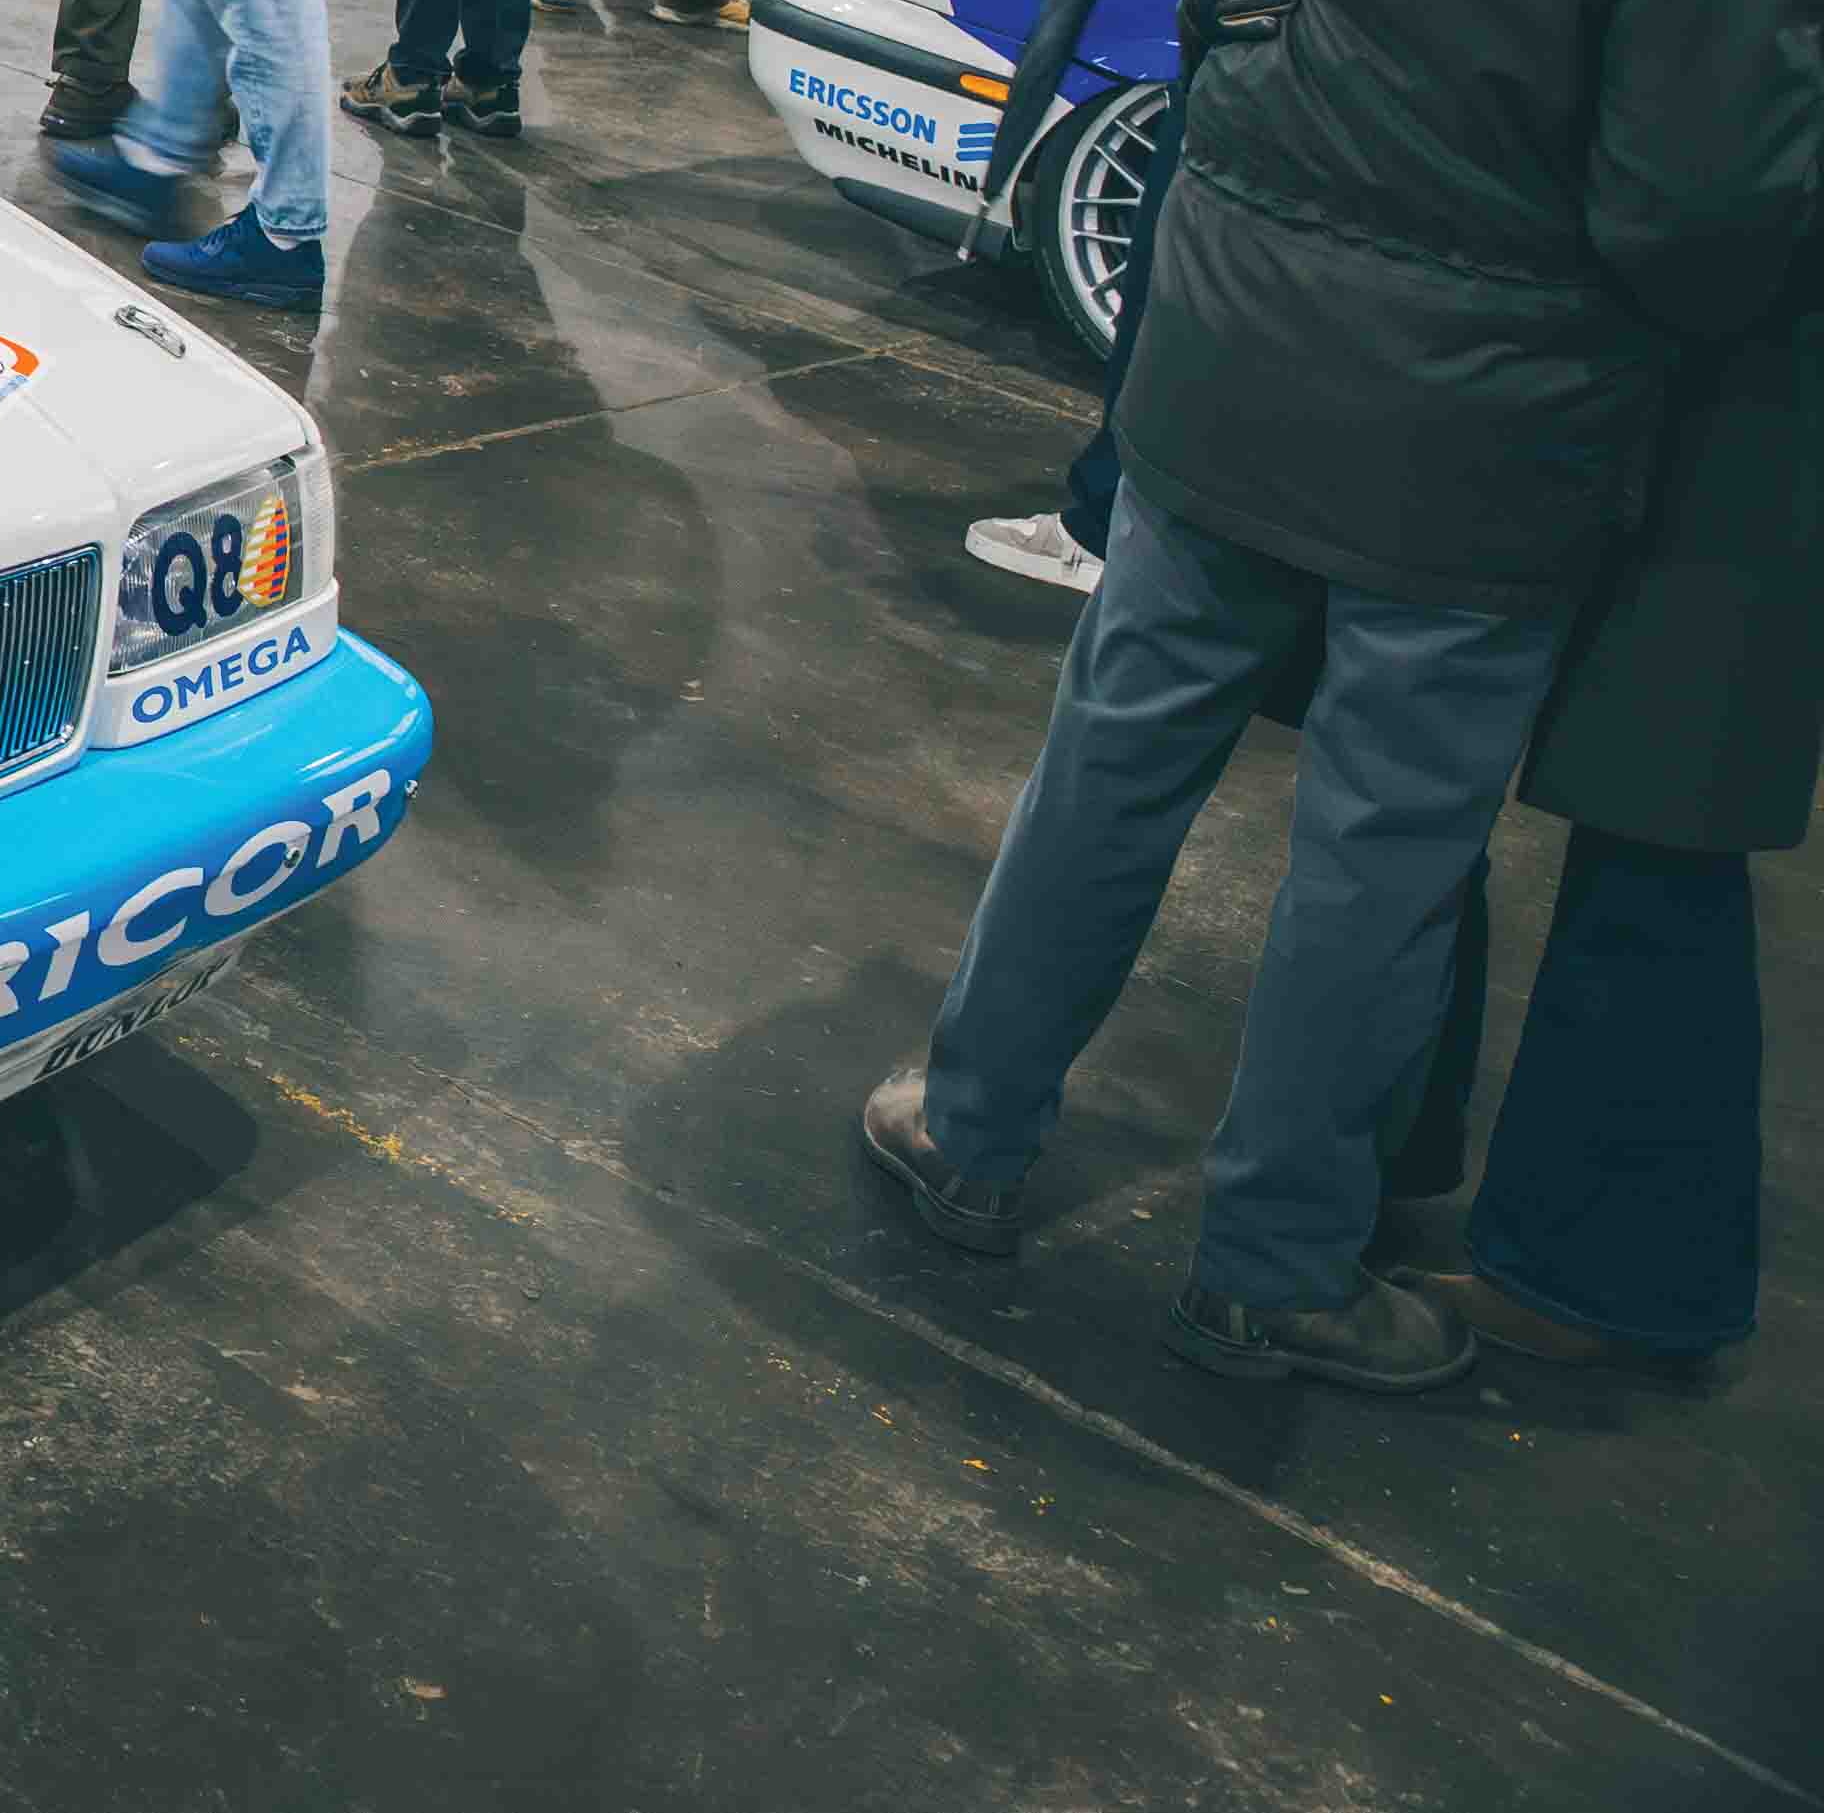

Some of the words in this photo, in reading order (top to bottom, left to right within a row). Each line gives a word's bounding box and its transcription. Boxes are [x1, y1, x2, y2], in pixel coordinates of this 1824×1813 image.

[789, 68, 937, 144] ERICSSON
[813, 117, 979, 193] MICHELIN
[151, 513, 244, 638] Q8
[131, 625, 312, 726] OMEGA
